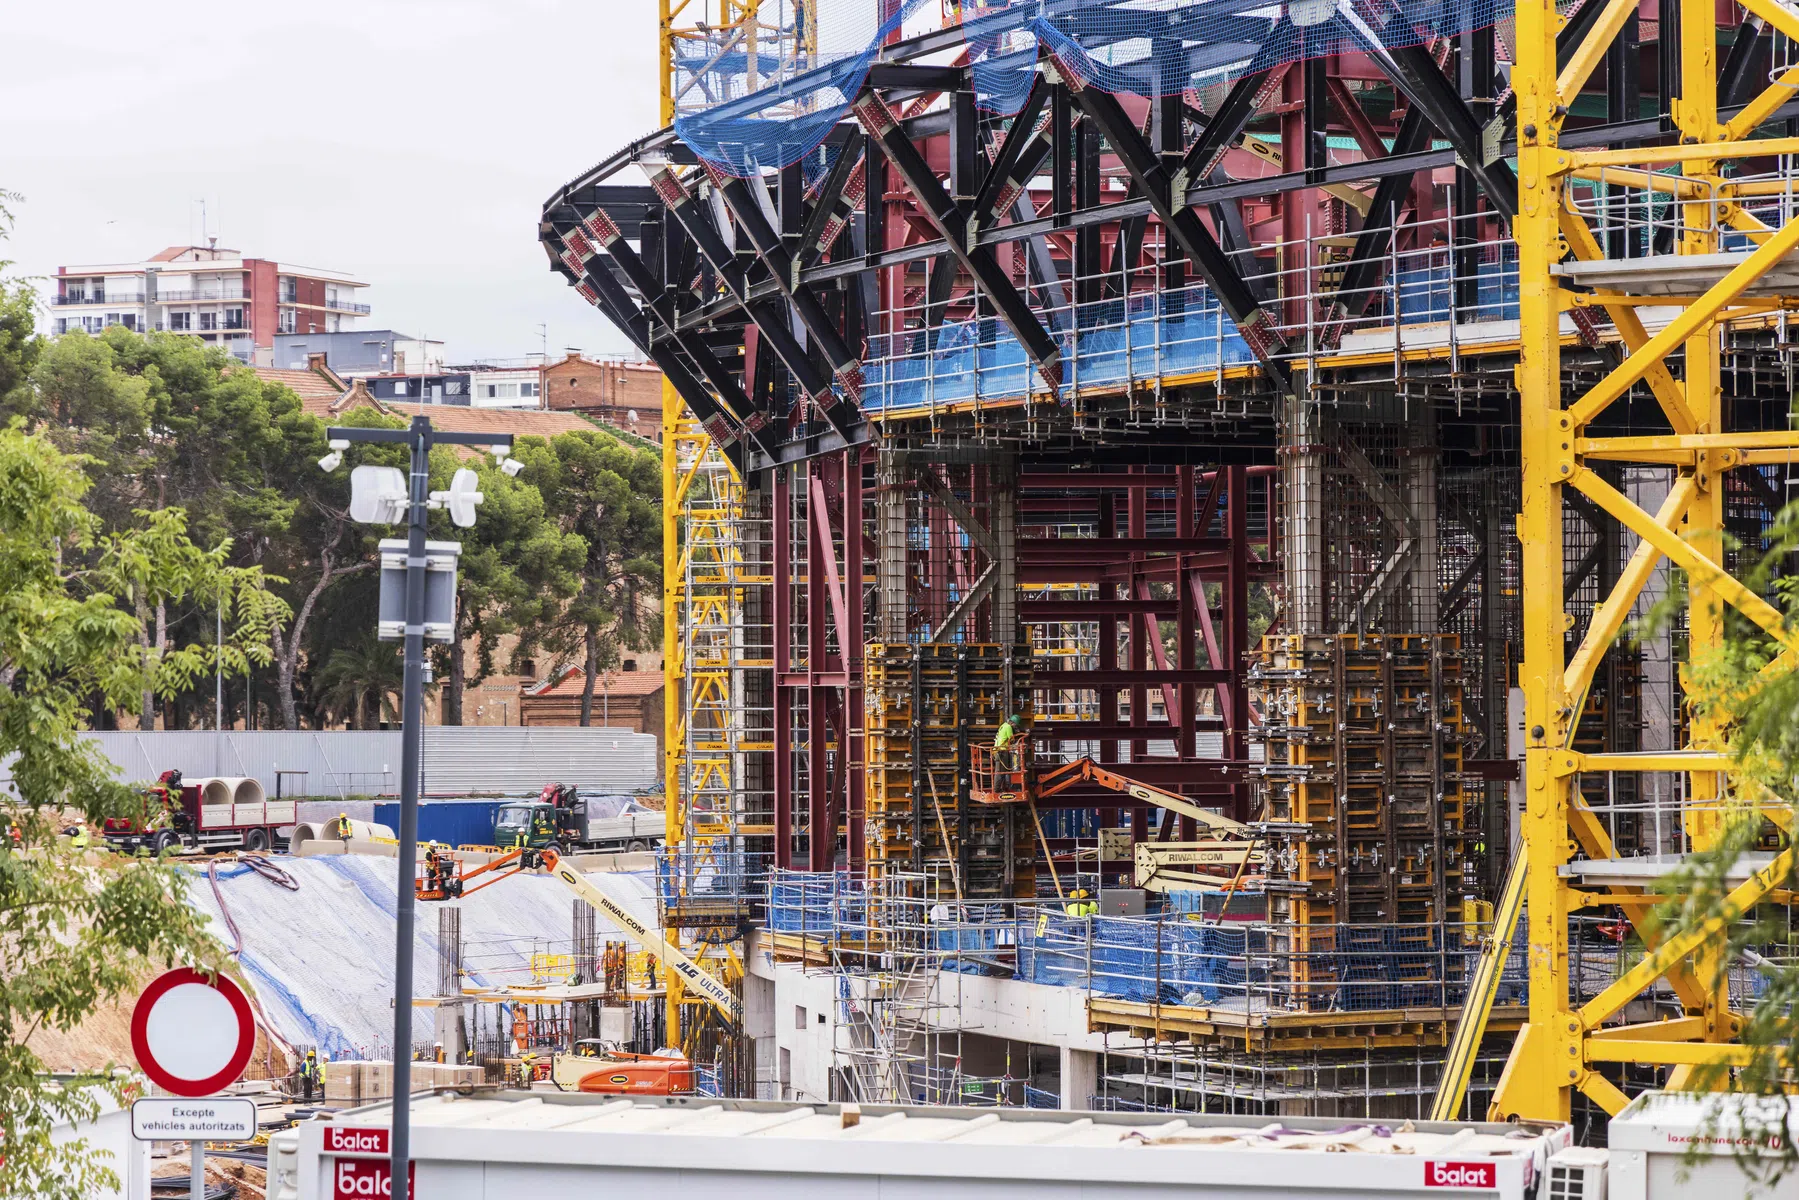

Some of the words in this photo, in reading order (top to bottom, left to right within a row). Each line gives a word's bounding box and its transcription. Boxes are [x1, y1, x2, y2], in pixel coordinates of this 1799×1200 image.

[1168, 853, 1223, 862] RIWAL.COM
[601, 898, 646, 936] RIWAL.COM
[675, 962, 699, 979] JLG
[699, 977, 730, 1005] ULTRA
[172, 1107, 215, 1119] Excepte
[142, 1121, 185, 1130] vehicles
[189, 1122, 245, 1131] autoritzats
[332, 1127, 380, 1150] balat
[338, 1162, 411, 1197] bala
[1433, 1160, 1487, 1185] balat
